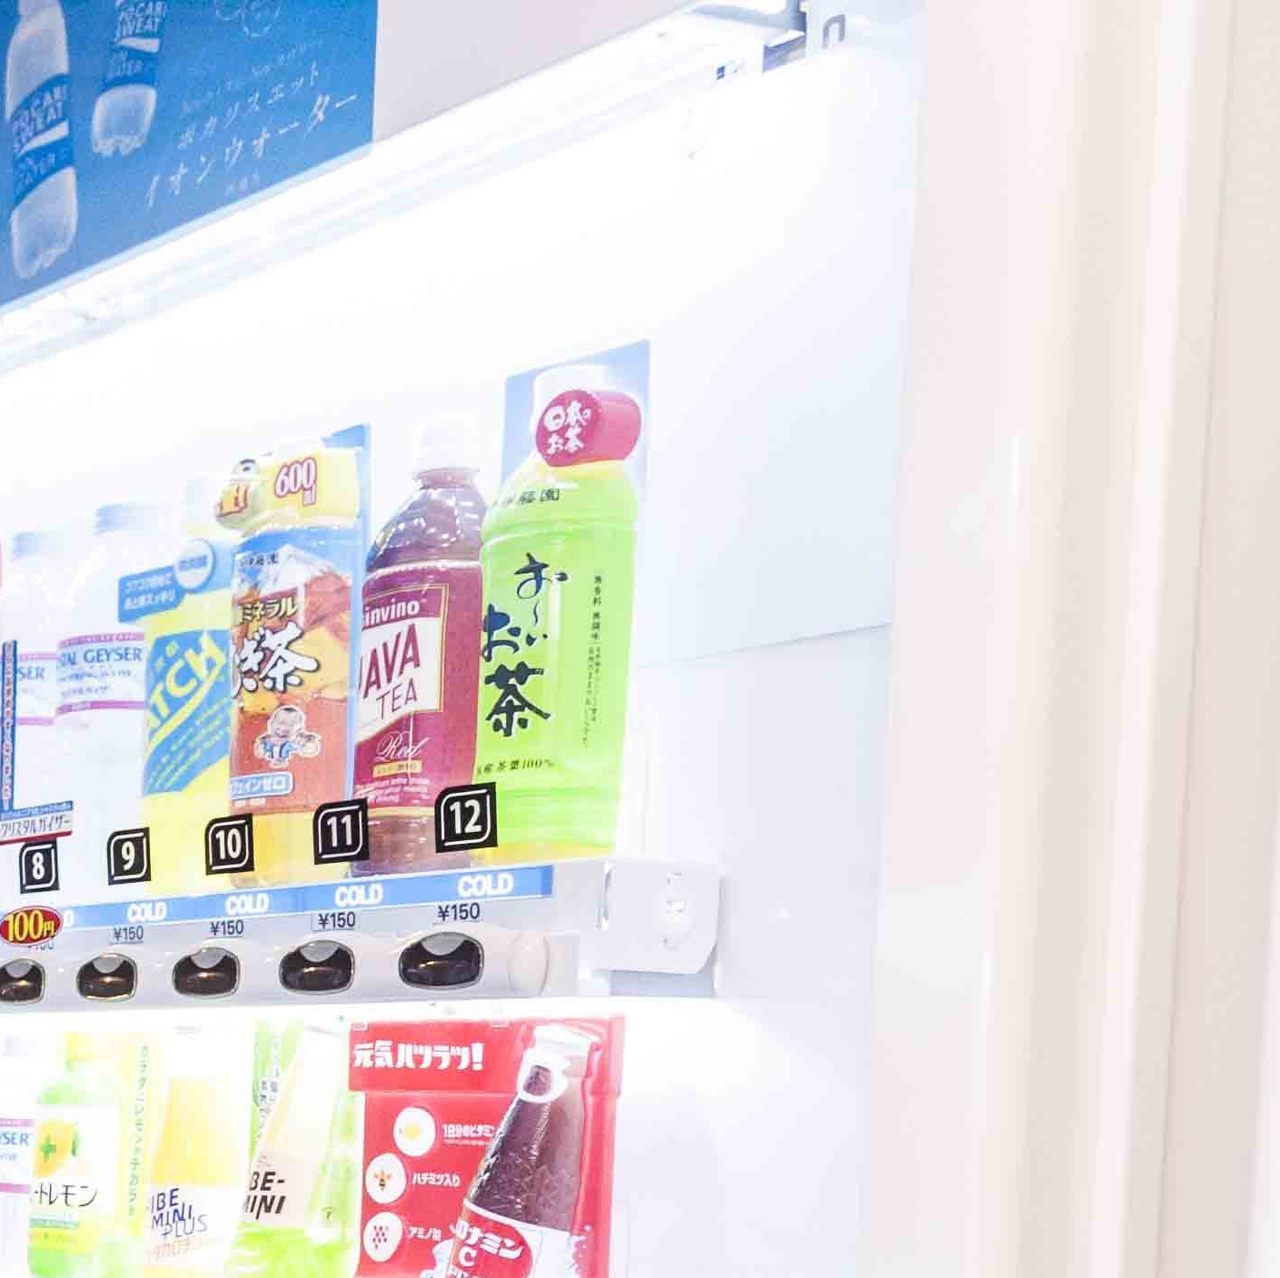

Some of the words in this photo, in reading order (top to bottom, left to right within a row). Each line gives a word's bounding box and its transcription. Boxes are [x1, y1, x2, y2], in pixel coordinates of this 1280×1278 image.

[83, 647, 143, 664] GEYSER
[377, 678, 417, 719] TEA
[448, 798, 483, 835] 12
[326, 814, 353, 847] 11
[120, 840, 137, 871] 9
[215, 829, 243, 860] 10
[33, 852, 45, 878] 8
[333, 883, 385, 908] COLD
[456, 872, 516, 897] COLD
[126, 900, 168, 923] COLD
[225, 893, 271, 917] COLD
[437, 902, 482, 921] ¥150
[5, 906, 55, 940] 100円
[210, 919, 245, 937] ¥150
[318, 911, 357, 929] ¥150
[114, 925, 144, 942] ¥150
[151, 1202, 194, 1231] MINI
[162, 1214, 209, 1236] PLUS
[459, 1246, 477, 1267] C
